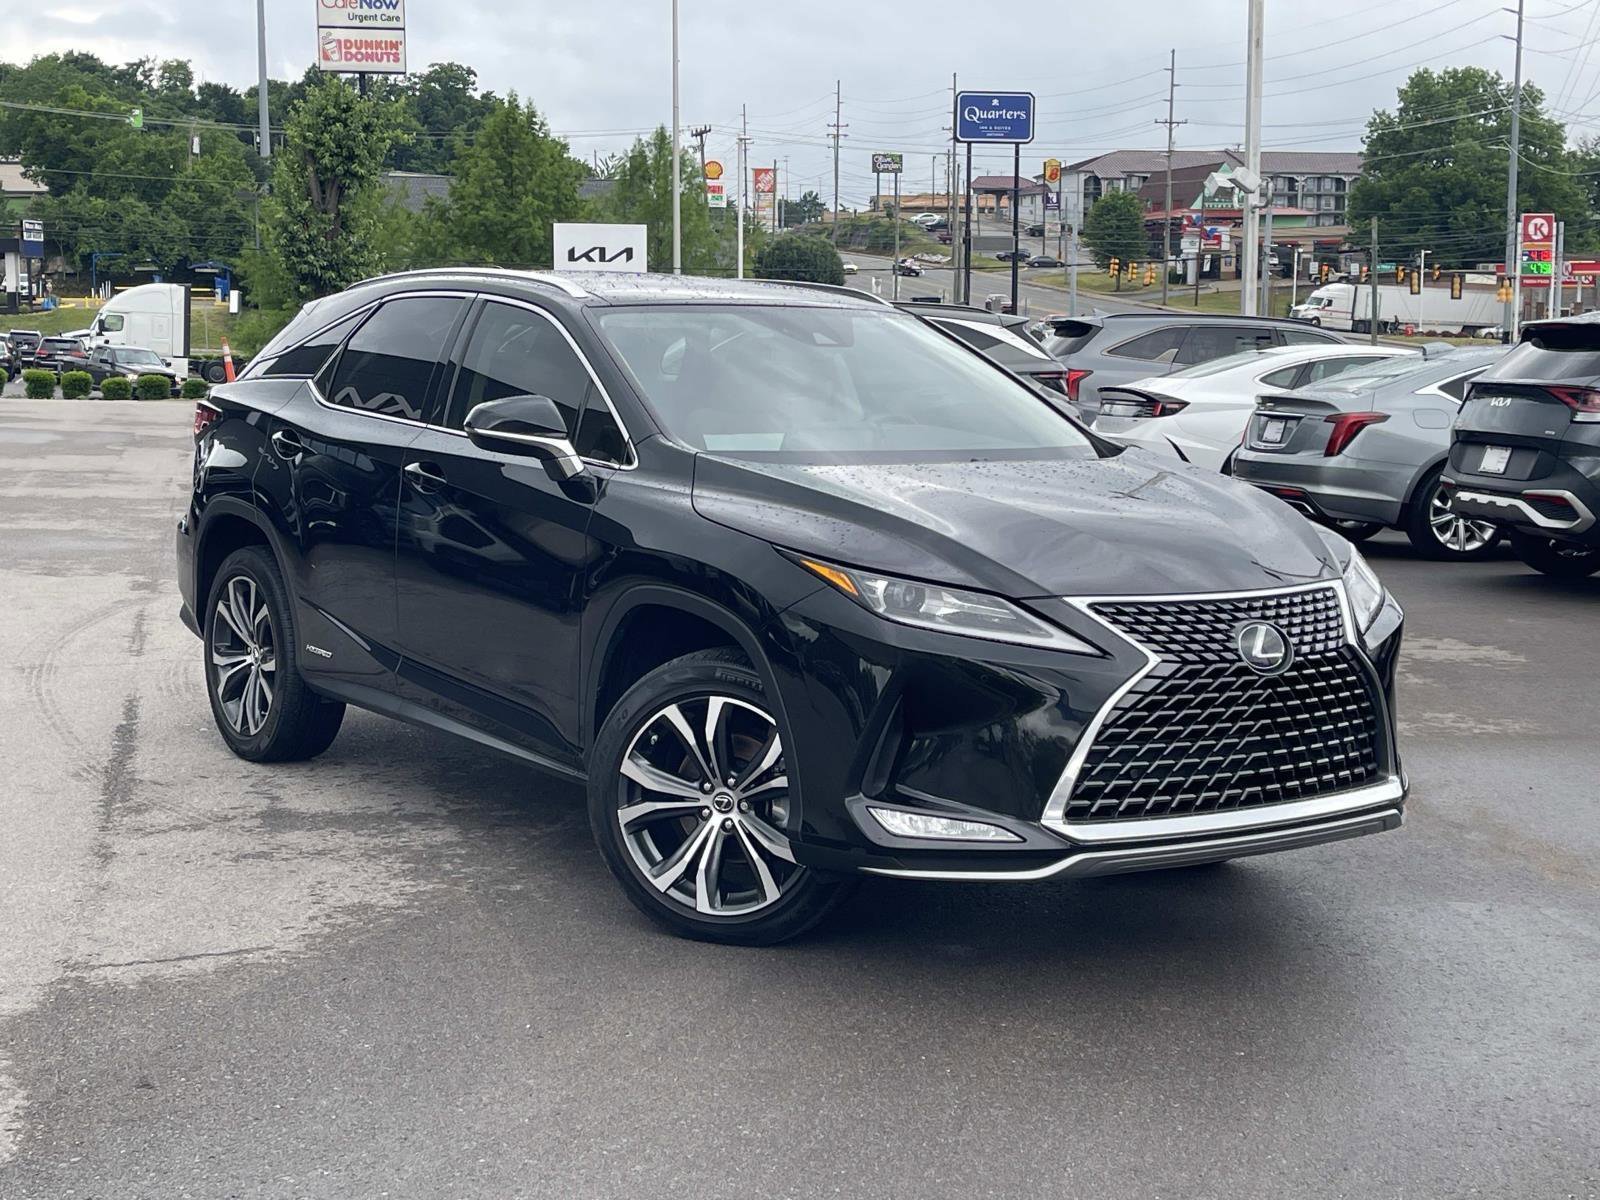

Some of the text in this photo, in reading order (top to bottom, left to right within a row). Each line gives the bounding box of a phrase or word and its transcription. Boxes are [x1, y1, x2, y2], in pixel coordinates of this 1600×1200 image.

[348, 13, 400, 23] Urgent Care
[343, 40, 402, 51] DUNKIN'
[343, 52, 400, 63] DONUTS
[964, 106, 1026, 123] Quarters
[1533, 223, 1547, 237] K
[568, 246, 633, 263] KIA
[1491, 397, 1512, 407] KIA
